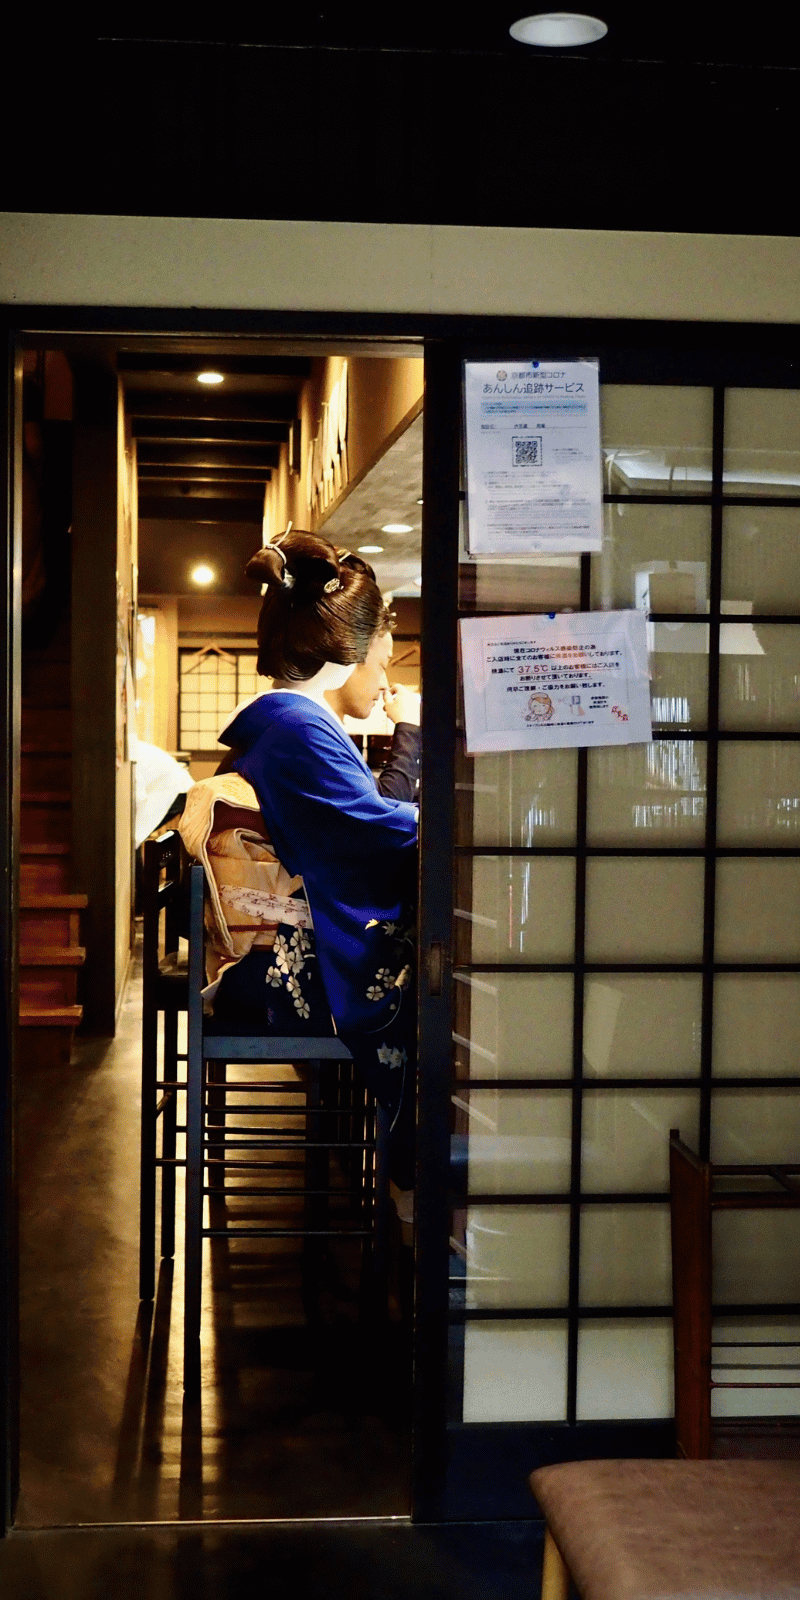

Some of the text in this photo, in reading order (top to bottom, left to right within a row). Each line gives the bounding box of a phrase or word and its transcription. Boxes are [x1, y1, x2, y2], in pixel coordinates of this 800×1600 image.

[482, 382, 584, 393] あんしん追跡サービス
[518, 664, 548, 673] 375℃
